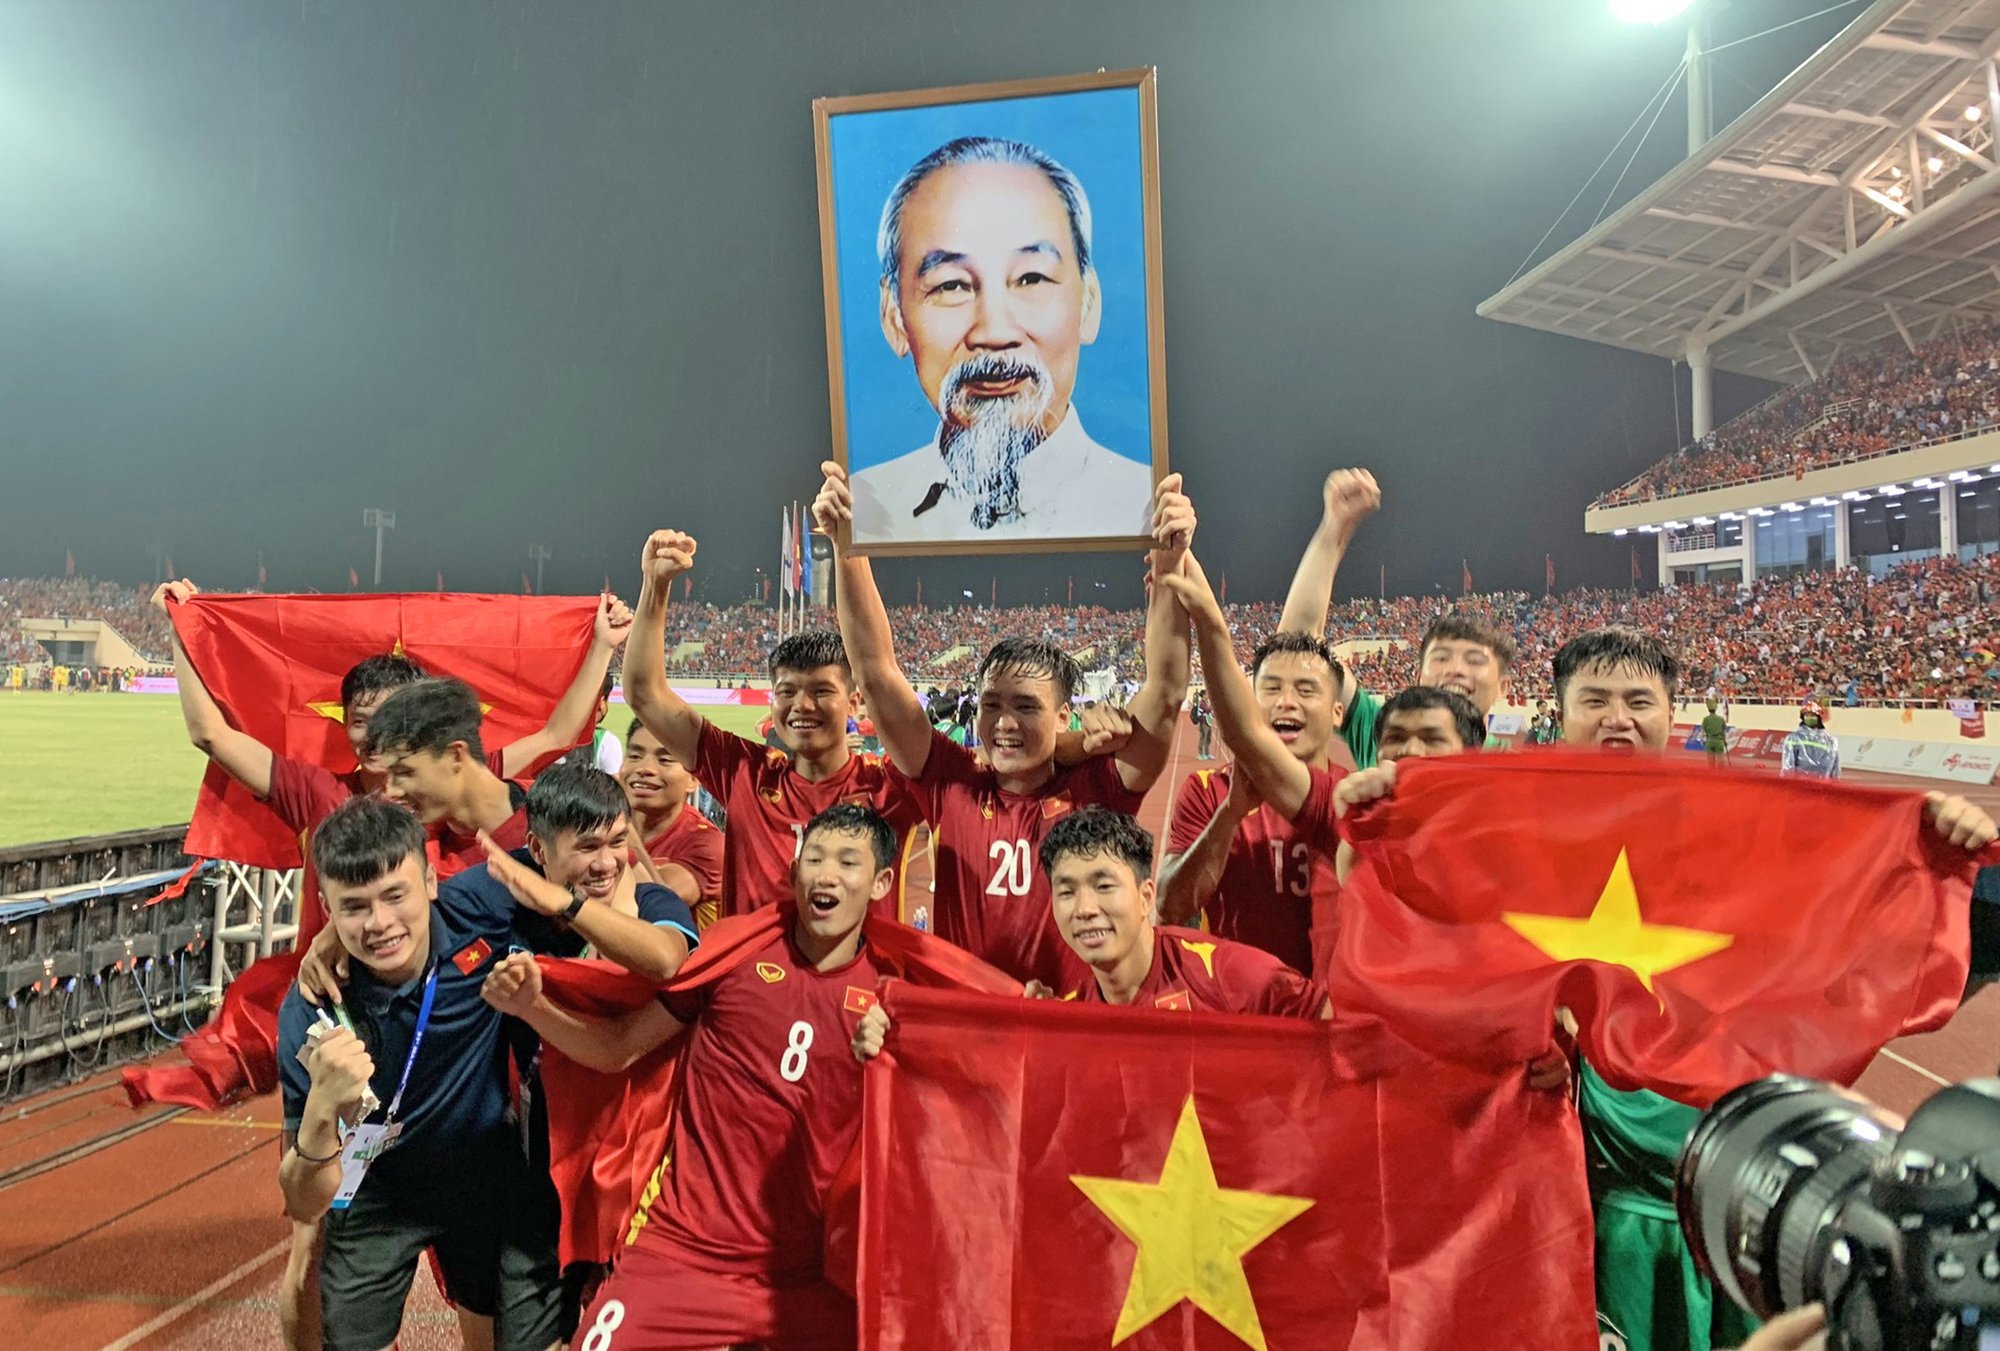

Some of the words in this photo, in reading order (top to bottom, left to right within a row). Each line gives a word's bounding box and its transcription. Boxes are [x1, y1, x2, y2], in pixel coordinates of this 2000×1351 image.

[986, 841, 1031, 896] 20
[1271, 840, 1311, 897] 13
[780, 1020, 814, 1082] 8
[581, 1300, 625, 1351] 8
